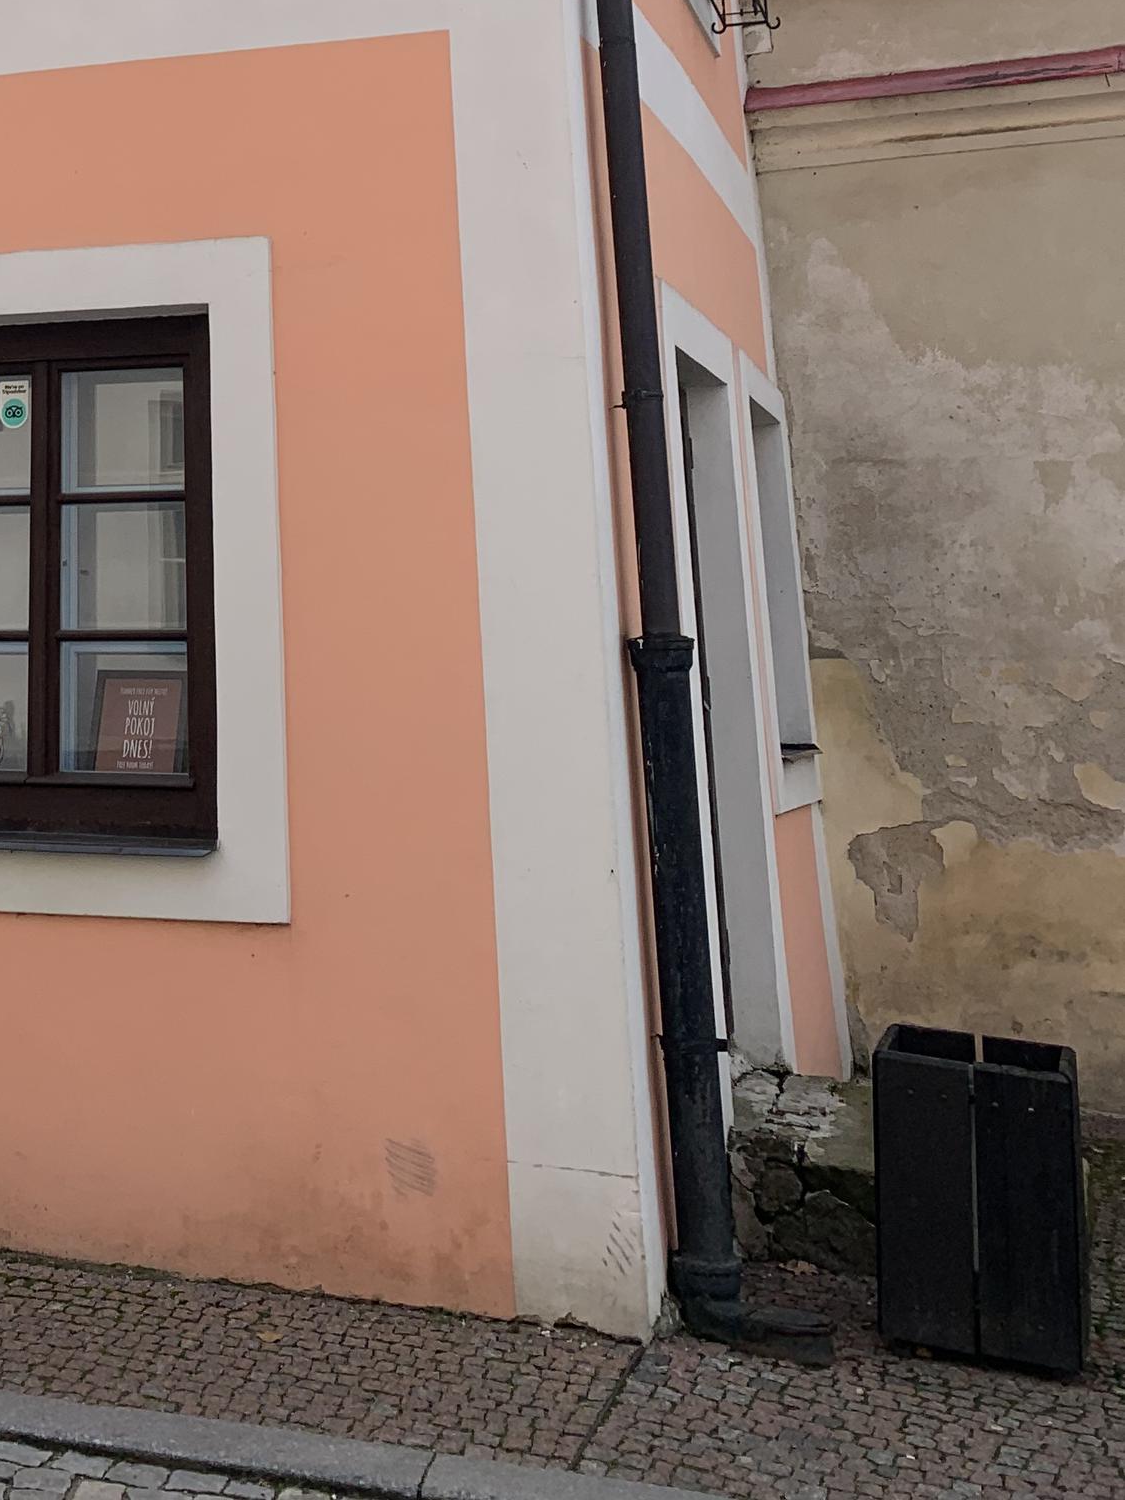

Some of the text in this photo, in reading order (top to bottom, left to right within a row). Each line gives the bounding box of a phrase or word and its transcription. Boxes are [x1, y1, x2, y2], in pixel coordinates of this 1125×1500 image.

[128, 696, 156, 716] VOLNÝ
[124, 717, 156, 739] POKOJ
[122, 739, 153, 759] DNES!
